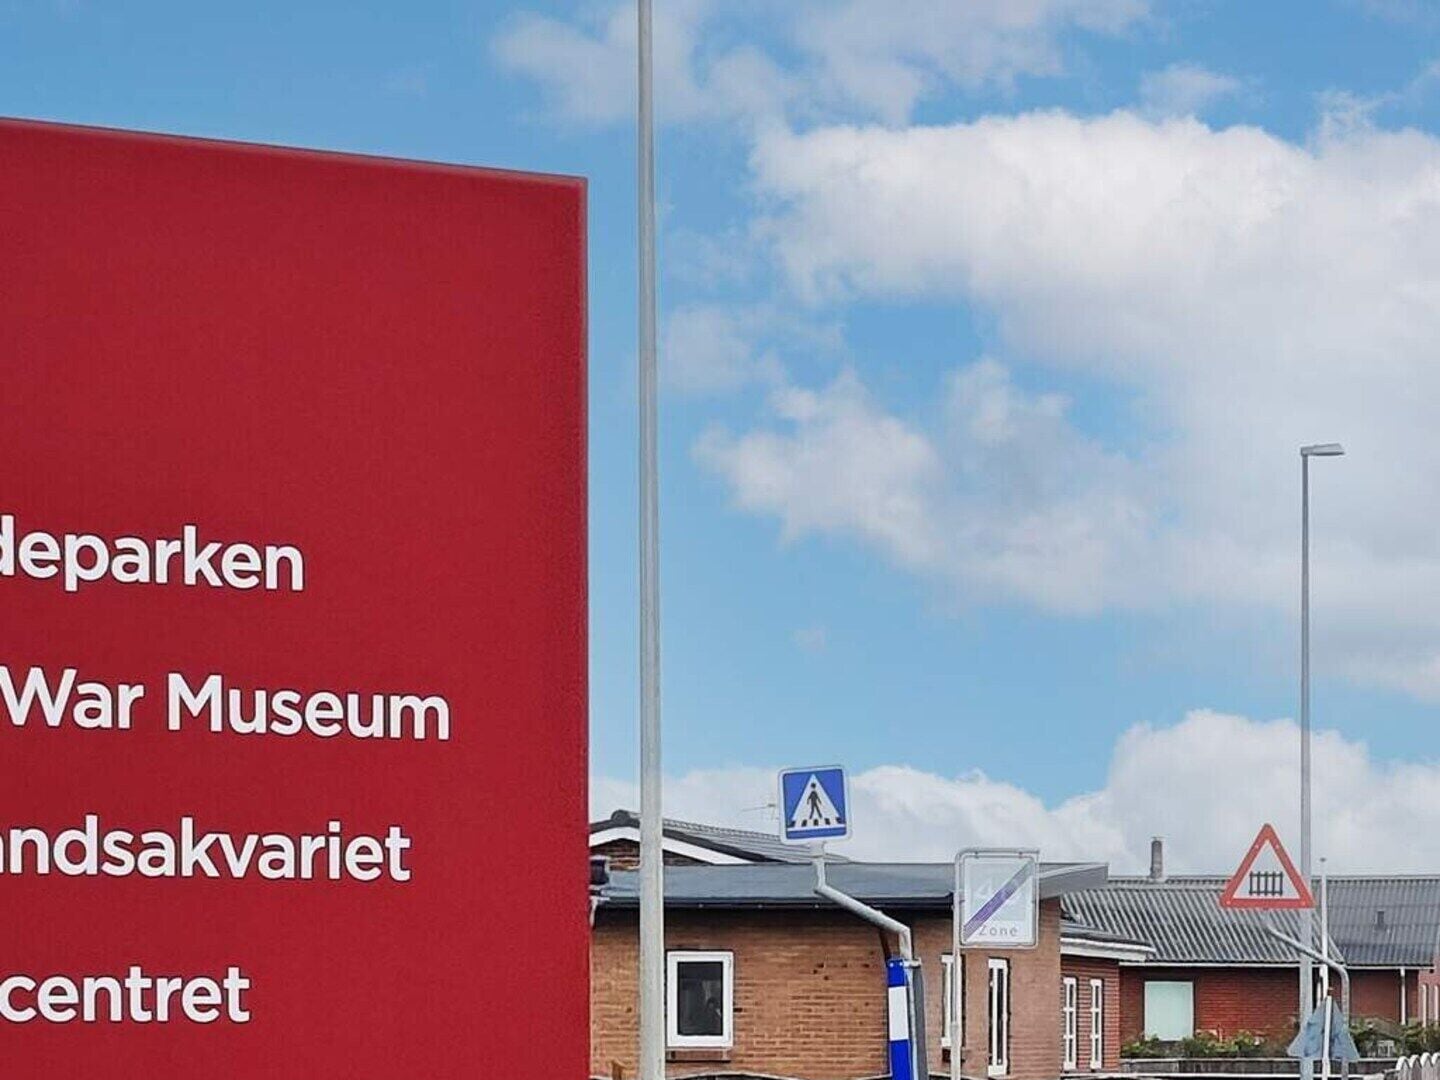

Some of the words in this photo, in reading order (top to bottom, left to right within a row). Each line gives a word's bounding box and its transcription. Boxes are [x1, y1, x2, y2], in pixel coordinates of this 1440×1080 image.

[0, 665, 146, 730] War
[167, 672, 451, 741] Museum
[0, 814, 412, 882] ndsakvariet
[0, 964, 251, 1024] centret
